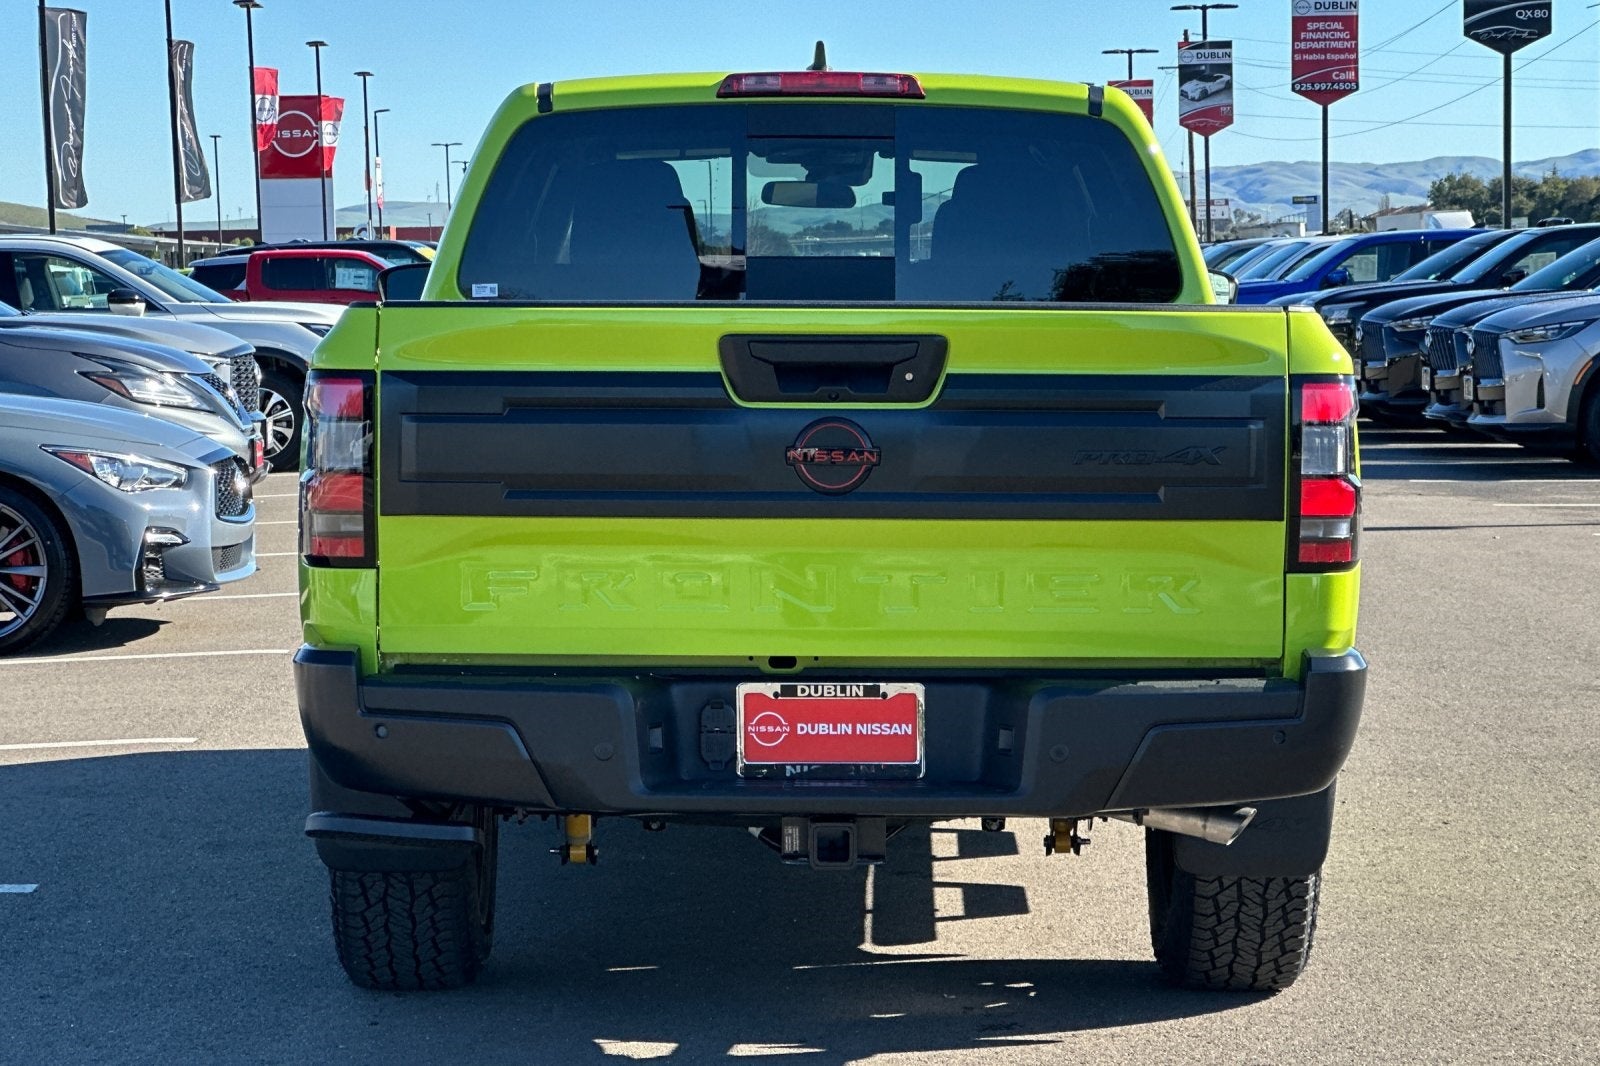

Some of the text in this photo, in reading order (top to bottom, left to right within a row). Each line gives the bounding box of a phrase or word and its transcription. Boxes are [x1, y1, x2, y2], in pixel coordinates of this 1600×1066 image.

[1314, 1, 1357, 10] DUBLIN
[1515, 9, 1549, 20] QX80
[1307, 22, 1344, 30] SPECIAL
[1295, 41, 1357, 49] DEPARTMENT
[1196, 51, 1231, 60] DUBLIN
[1326, 52, 1357, 61] Español
[1332, 72, 1355, 80] Call!
[1294, 82, 1357, 91] 925.997.4505
[277, 129, 319, 138] ISSAN
[789, 450, 877, 462] NISSAN
[1072, 445, 1227, 465] PRO-4X
[459, 562, 1201, 616] FRONTIER
[796, 685, 864, 697] DUBLIN
[747, 725, 790, 733] NISSAN
[796, 723, 912, 735] DUBLIN NISSAN
